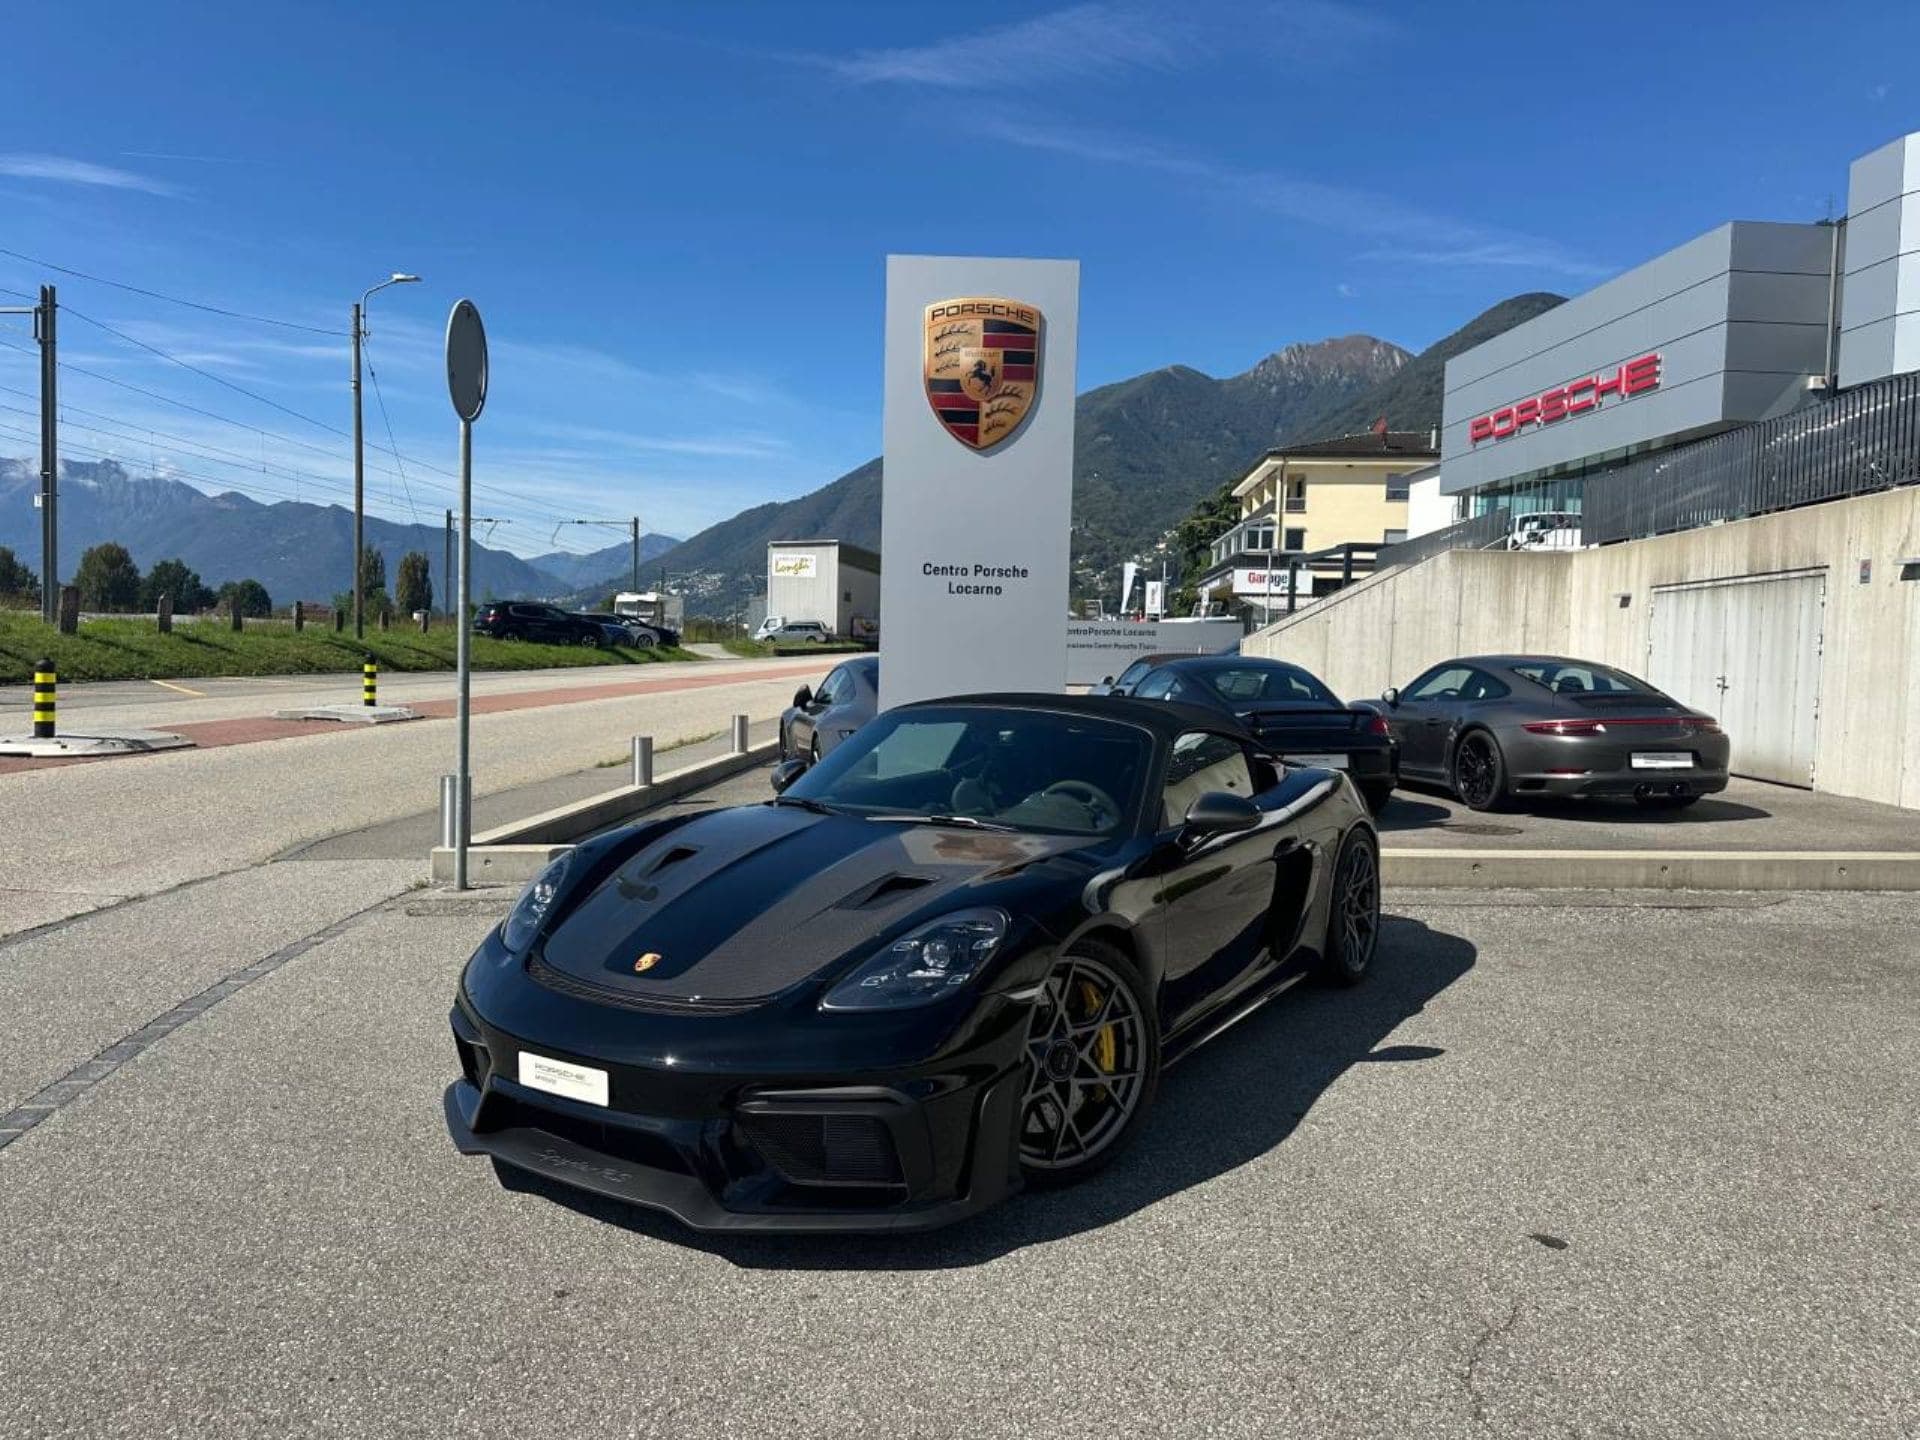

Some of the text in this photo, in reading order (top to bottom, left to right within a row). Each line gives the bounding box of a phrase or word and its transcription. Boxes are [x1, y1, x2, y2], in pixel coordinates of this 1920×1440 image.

[931, 303, 1035, 324] PORSCHE
[1470, 353, 1662, 447] PORSCHE
[923, 563, 1028, 578] Centro Porsche
[948, 581, 1002, 595] Locarno
